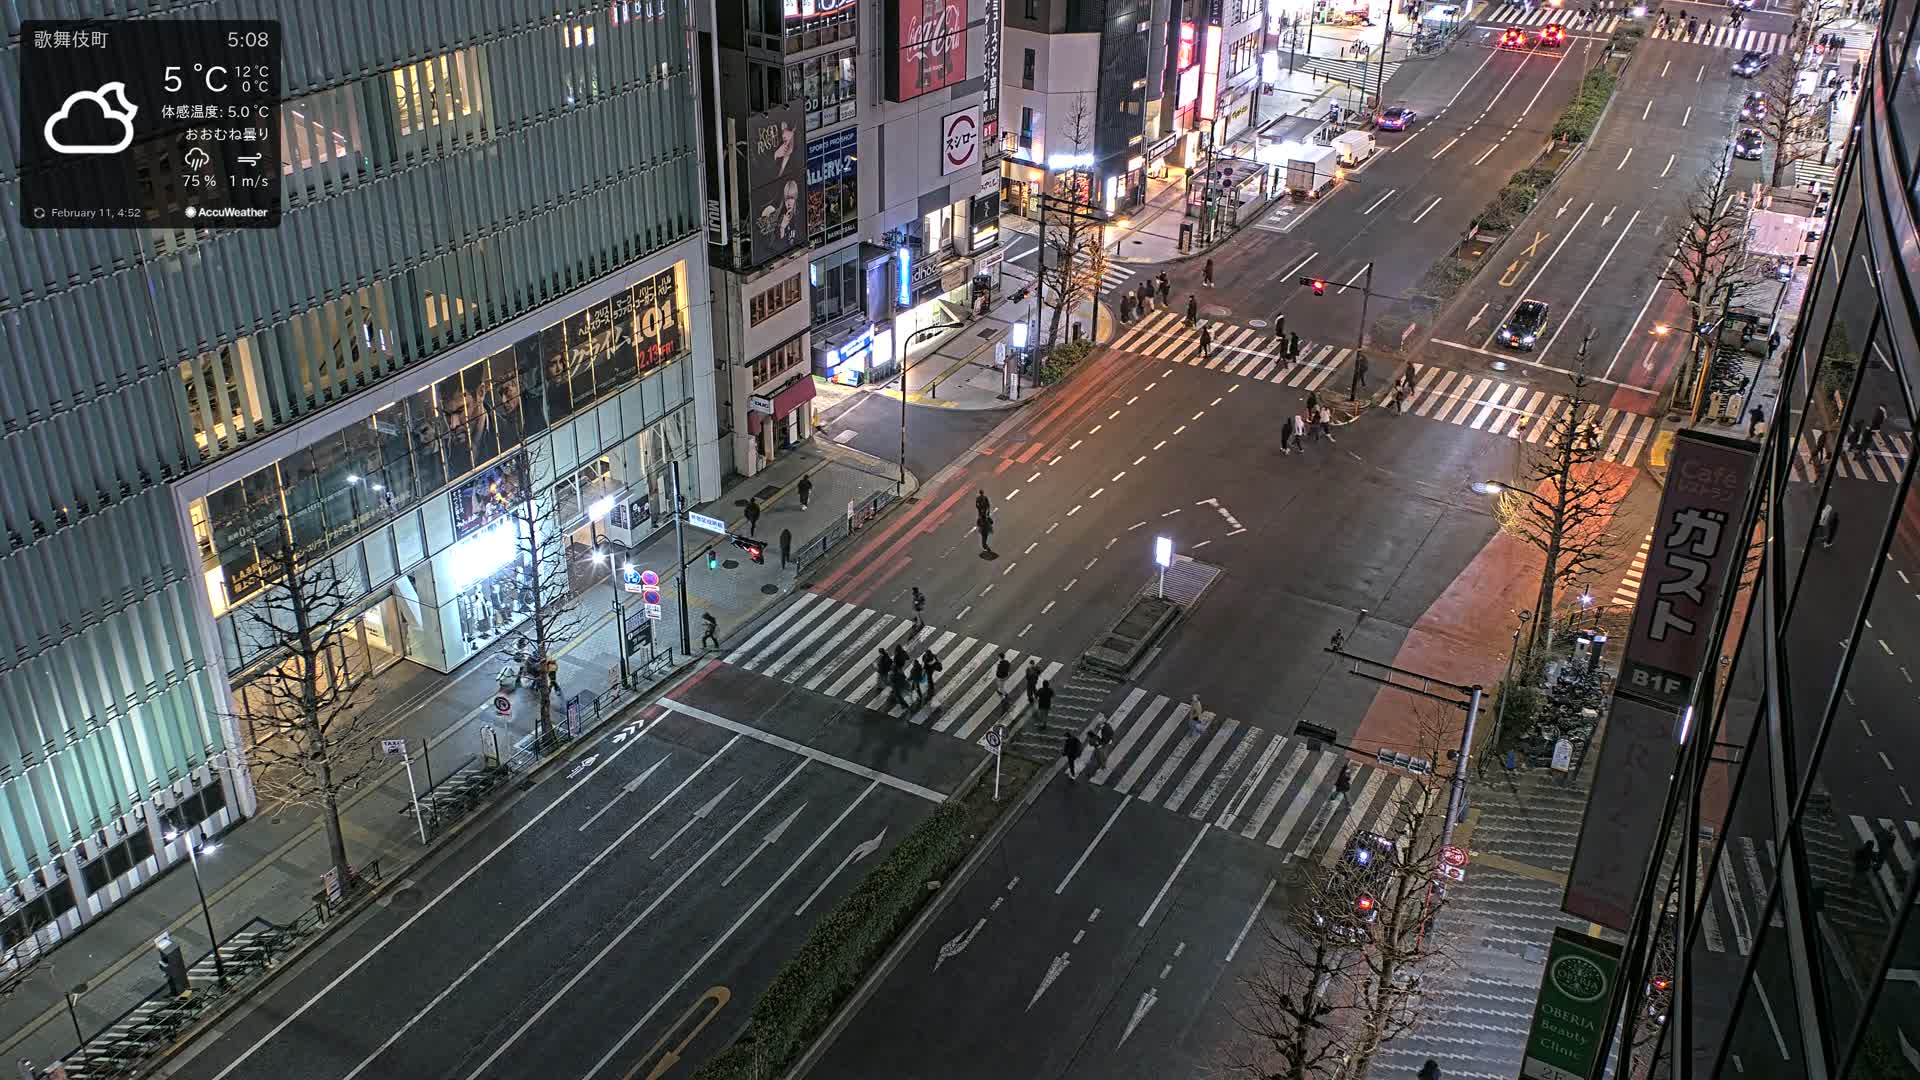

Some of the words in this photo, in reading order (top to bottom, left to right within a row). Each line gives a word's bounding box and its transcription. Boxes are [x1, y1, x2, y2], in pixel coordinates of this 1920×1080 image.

[945, 133, 977, 152] スシロー
[708, 200, 720, 233] MUJI
[631, 299, 675, 348] 101
[1650, 508, 1725, 641] ガスト
[1631, 668, 1681, 695] B1F
[1541, 1003, 1595, 1031] OBERIA
[1541, 1019, 1586, 1046] Beauty
[1540, 1038, 1582, 1061] Clinic
